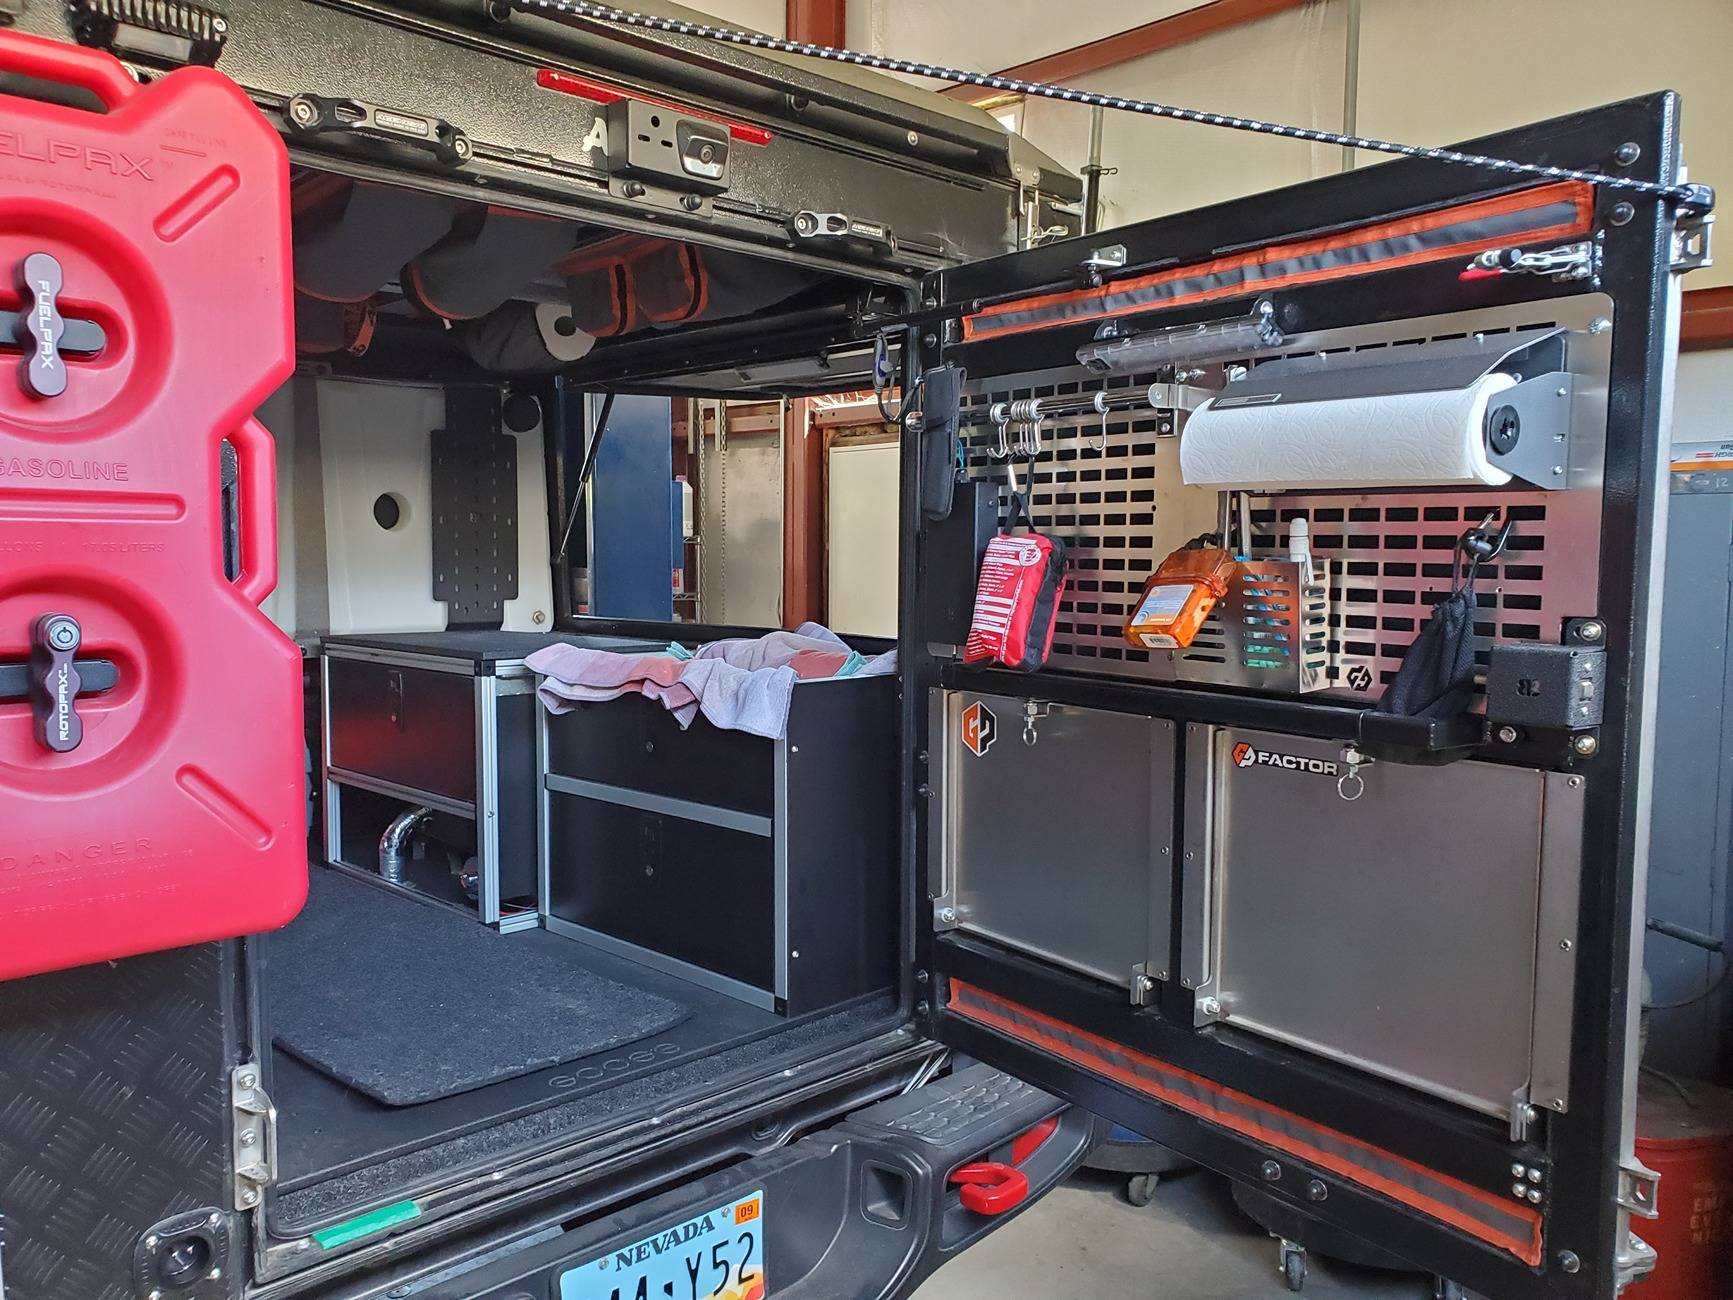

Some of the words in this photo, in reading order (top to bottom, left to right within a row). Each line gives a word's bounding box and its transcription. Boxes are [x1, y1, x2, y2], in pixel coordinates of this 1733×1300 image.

[37, 279, 54, 370] FUELPAX
[0, 457, 129, 481] ASOLINE
[58, 669, 69, 741] ROTOPAX
[1258, 751, 1339, 776] FACTOR
[0, 837, 151, 871] DANGER
[740, 1204, 754, 1218] 09
[615, 1215, 716, 1272] NEVADA
